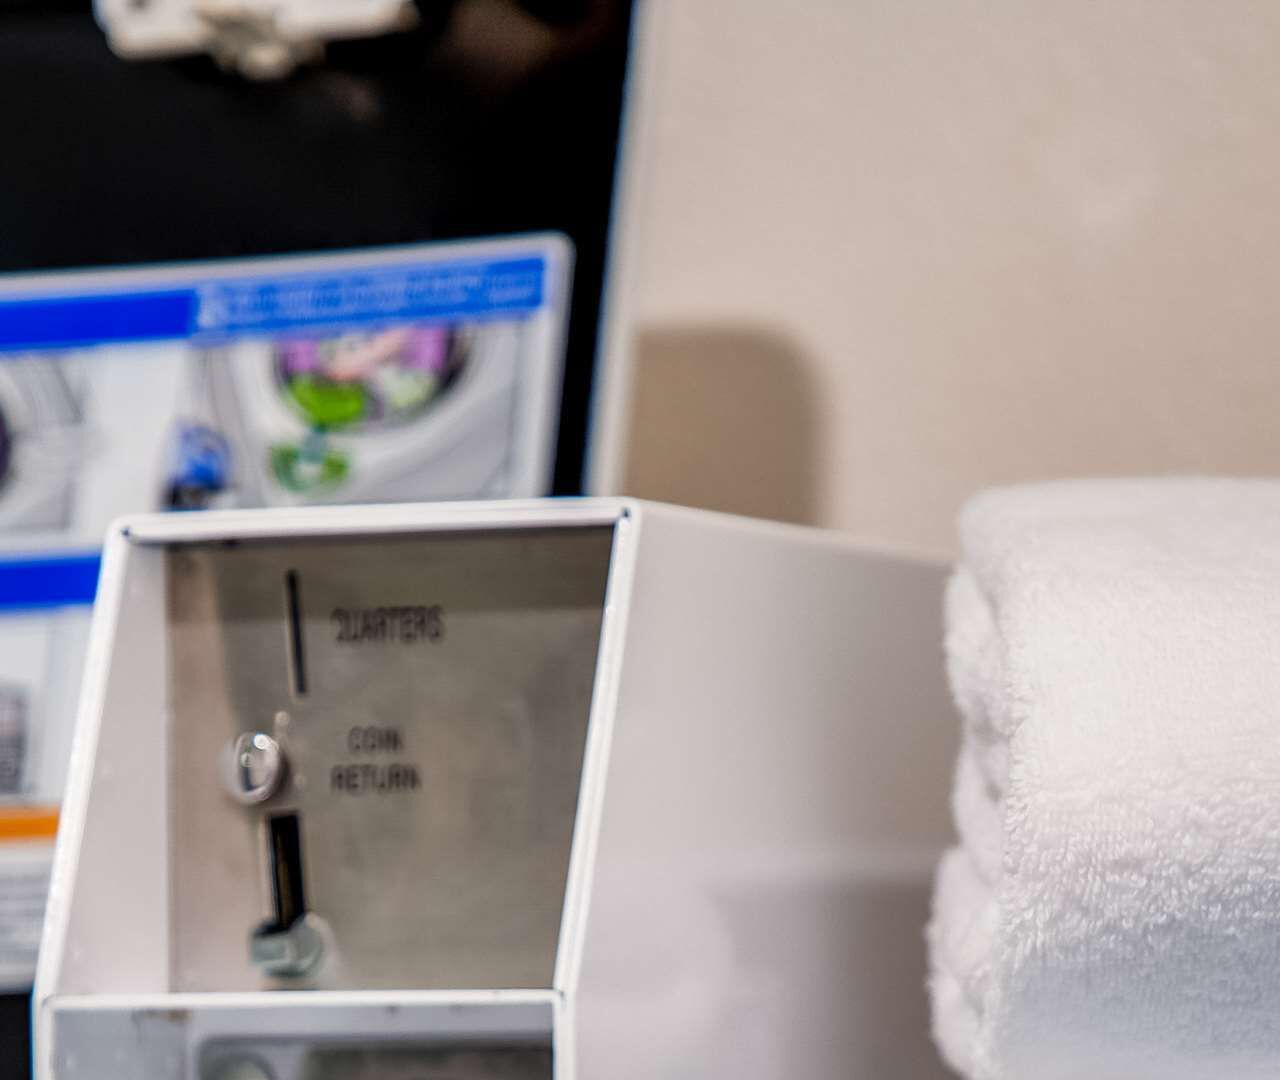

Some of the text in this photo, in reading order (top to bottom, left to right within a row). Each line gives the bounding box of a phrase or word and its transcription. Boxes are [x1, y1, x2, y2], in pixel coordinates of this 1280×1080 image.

[330, 605, 444, 642] QUARTERS
[348, 724, 403, 753] COIN
[330, 763, 422, 791] RETURN
